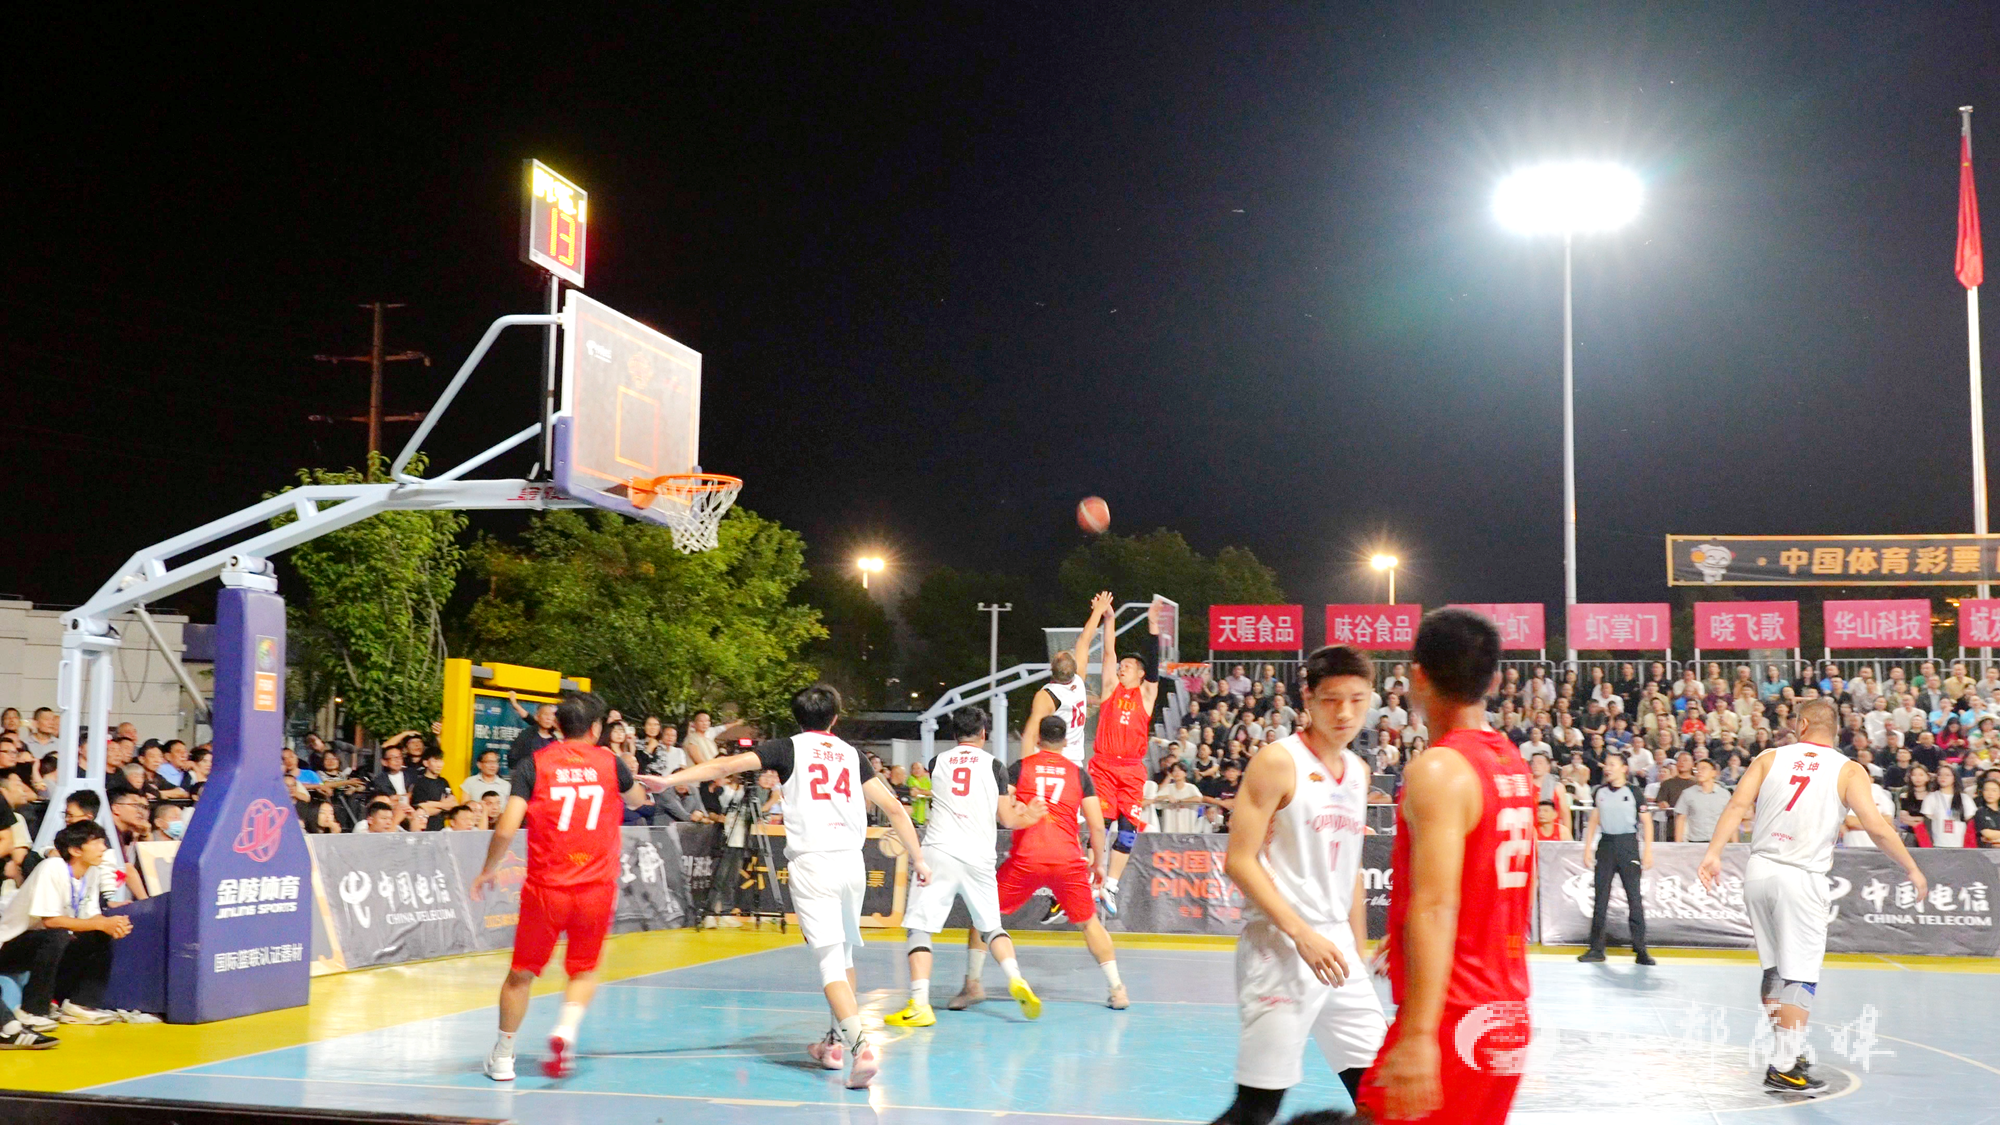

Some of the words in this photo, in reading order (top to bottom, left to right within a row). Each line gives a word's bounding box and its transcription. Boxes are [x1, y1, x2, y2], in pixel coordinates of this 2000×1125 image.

[549, 207, 576, 266] 13
[1779, 546, 1981, 575] 中国体育彩票
[1218, 615, 1294, 643] 天喔食品
[1334, 615, 1412, 643] 味谷食品
[1586, 613, 1658, 643] 虾掌门
[1710, 612, 1785, 642] 晓飞歌
[1834, 611, 1922, 640] 华山科技
[1792, 760, 1820, 771] 余坤
[808, 763, 851, 802] 24
[951, 767, 971, 797] 9
[1035, 777, 1065, 804] 17
[1785, 775, 1811, 811] 7
[550, 785, 604, 831] 77
[216, 876, 300, 905] 金陵体育
[377, 869, 451, 912] 中国电信
[1640, 876, 1746, 905] 国电信
[1861, 878, 1990, 913] 中国电信
[257, 902, 297, 914] SPORTS
[386, 912, 416, 925] CHINA
[415, 908, 457, 923] TELECOM
[1863, 913, 1916, 925] CHINA
[1916, 914, 1993, 927] TELECOM
[214, 943, 303, 973] 国际篮联认证器材
